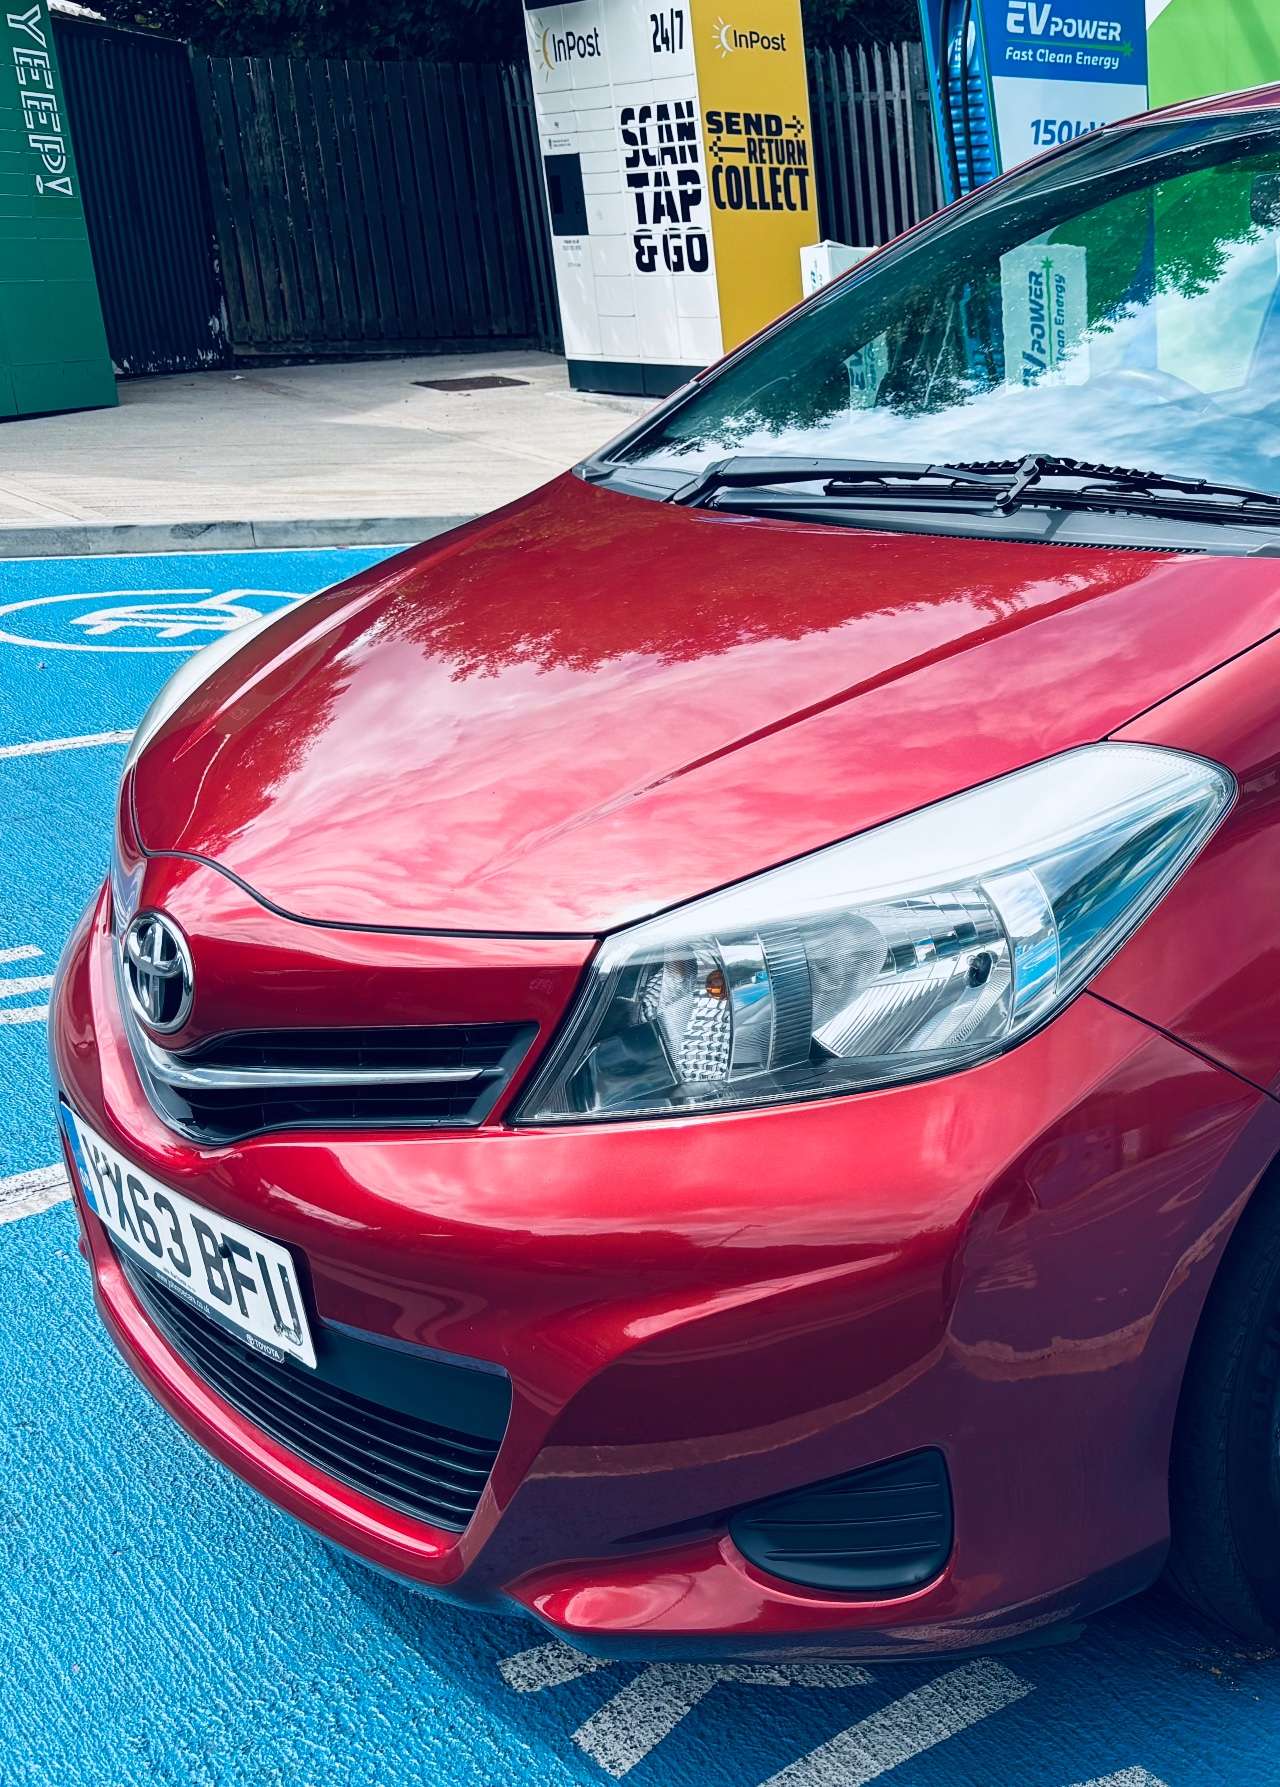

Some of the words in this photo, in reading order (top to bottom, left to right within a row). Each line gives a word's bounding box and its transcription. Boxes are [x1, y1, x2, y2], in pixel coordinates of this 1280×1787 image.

[552, 27, 602, 63] InPost
[650, 8, 684, 54] 24/7
[733, 29, 787, 52] InPost
[1005, 46, 1033, 62] Fast
[1035, 49, 1074, 65] Clean
[1076, 52, 1120, 70] Energy
[6, 4, 73, 197] YEEP!
[620, 100, 699, 169] SCAN
[705, 110, 783, 137] SEND
[1030, 119, 1105, 146] 150k
[745, 137, 808, 167] RETURN
[625, 169, 702, 225] TAP
[711, 164, 810, 212] COLLECT
[189, 1213, 304, 1346] BFU
